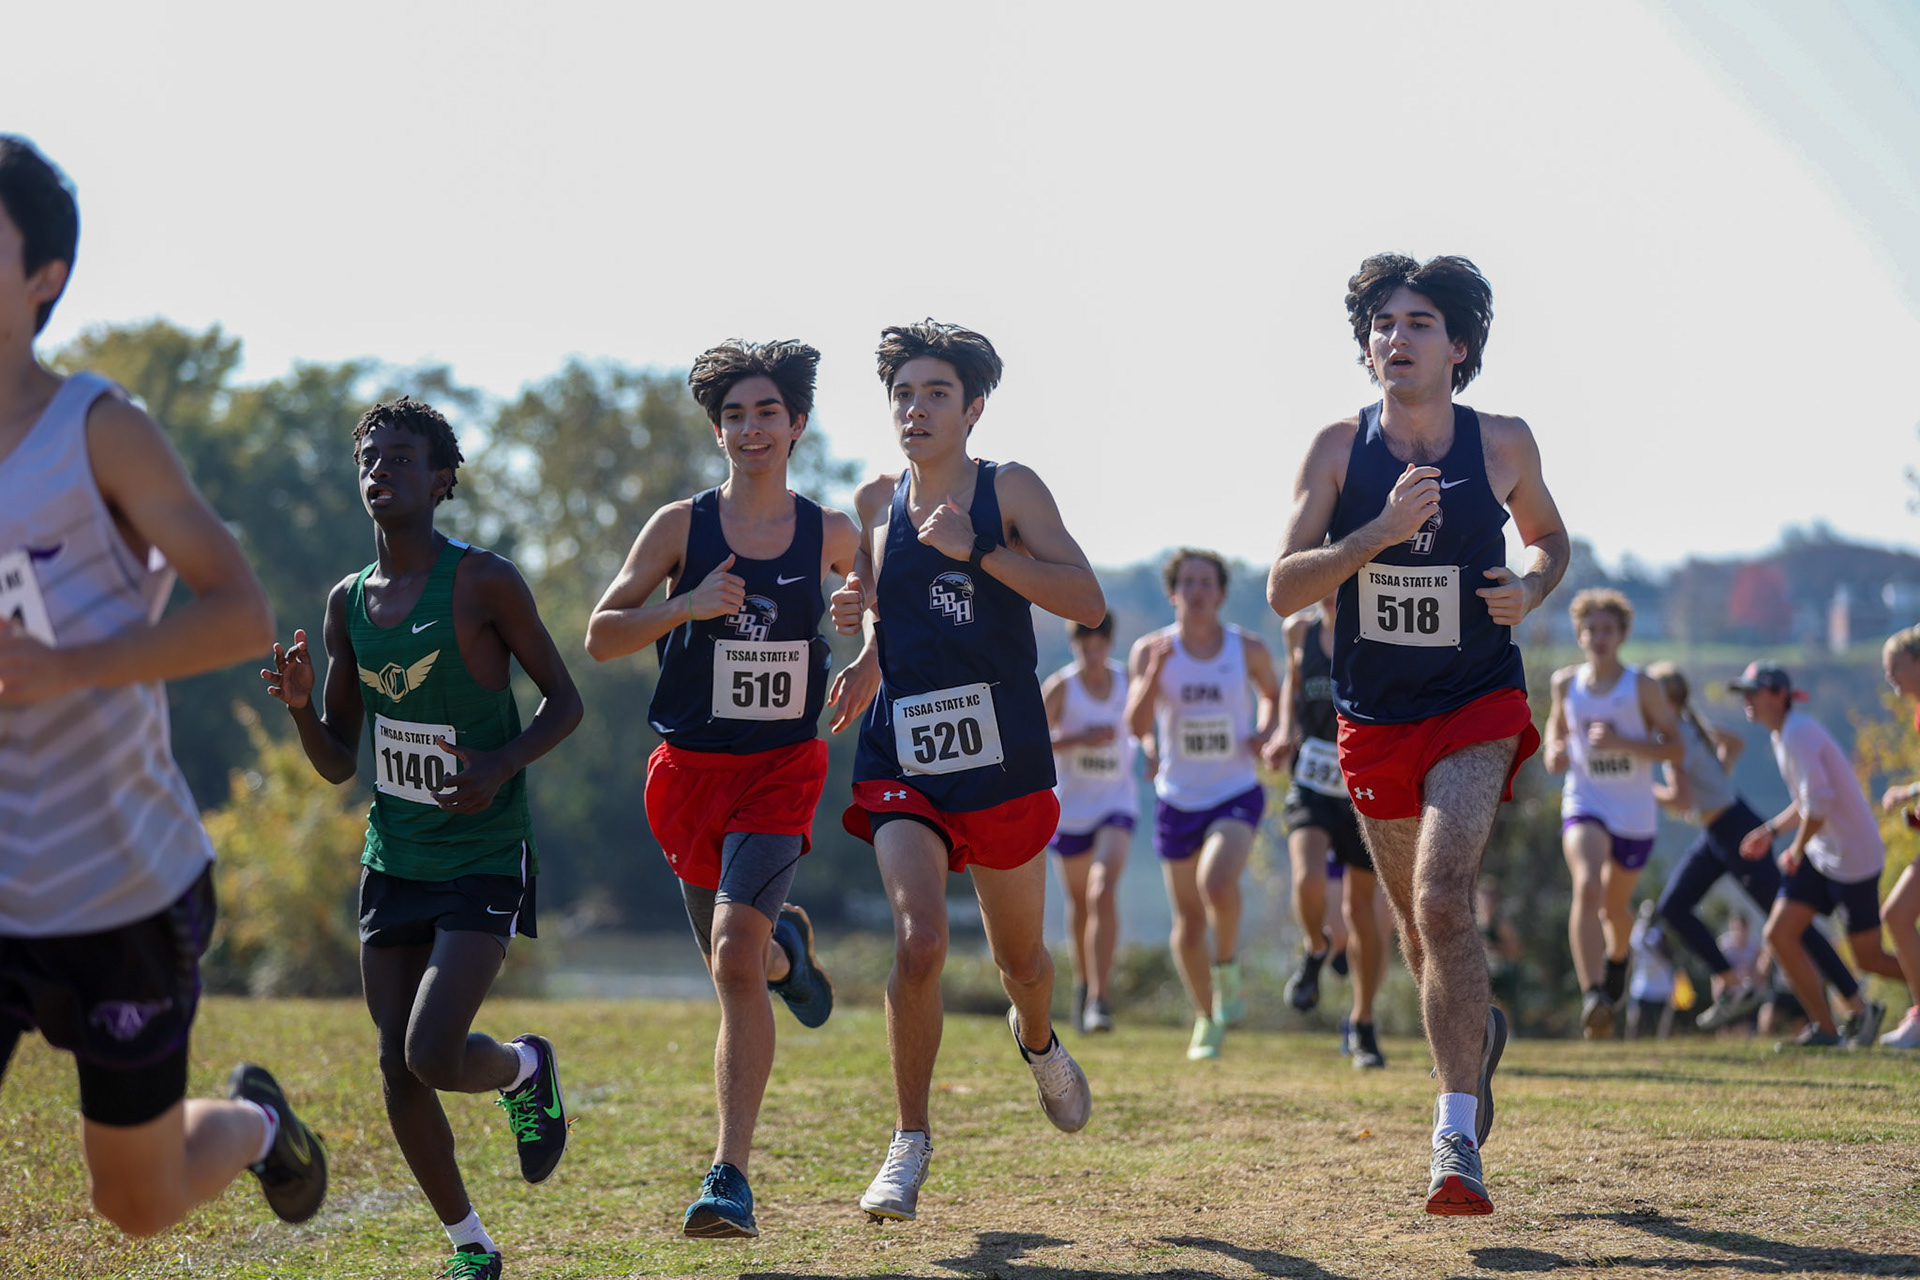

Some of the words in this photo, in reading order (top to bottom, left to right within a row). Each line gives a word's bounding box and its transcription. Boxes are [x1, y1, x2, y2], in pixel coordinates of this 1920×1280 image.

[1368, 572, 1400, 587] TSSAA
[1402, 576, 1433, 588] STATE
[1434, 576, 1448, 587] XC
[931, 585, 972, 623] SBA
[1377, 594, 1440, 634] 518
[726, 650, 758, 662] TSSAA
[760, 651, 787, 662] STATE
[788, 650, 800, 662] XC
[732, 671, 792, 708] 519
[903, 702, 934, 719] TSSAA
[934, 696, 965, 713] STATE
[966, 694, 981, 707] XC
[405, 732, 431, 745] STATE
[911, 717, 983, 765] 520
[381, 747, 444, 792] 1140
